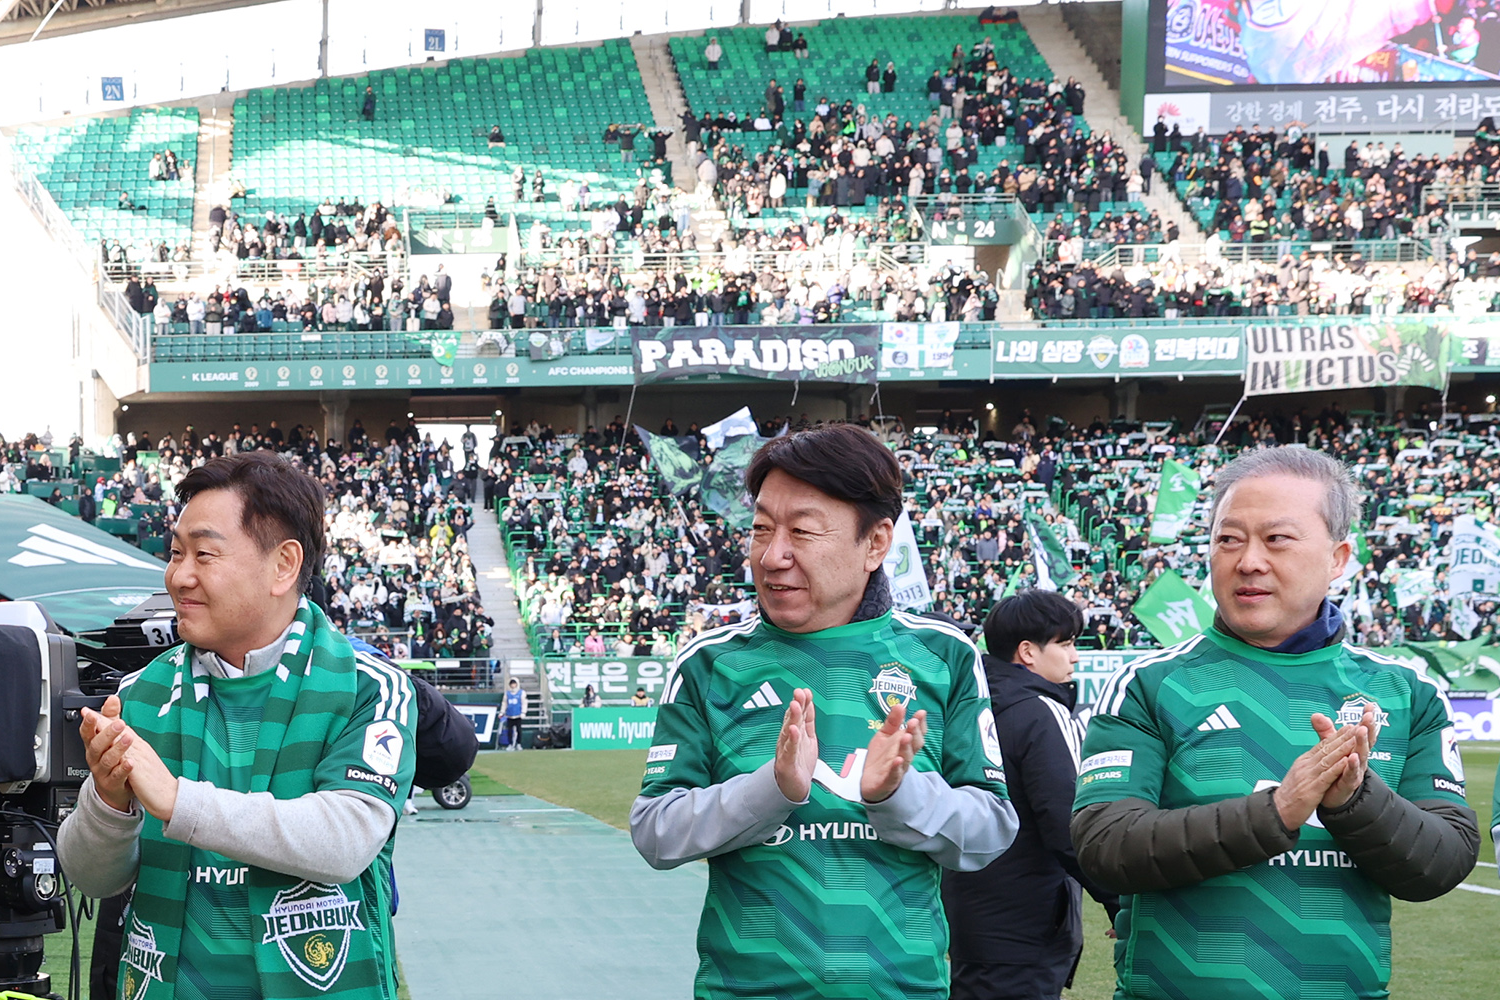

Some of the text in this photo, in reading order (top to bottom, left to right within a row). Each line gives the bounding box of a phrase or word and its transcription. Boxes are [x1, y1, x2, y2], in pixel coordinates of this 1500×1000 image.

[428, 36, 442, 50] 2L
[104, 84, 121, 100] 2N
[1226, 102, 1262, 122] 강한
[1268, 100, 1303, 121] 경제
[1313, 97, 1368, 124] 전주,
[1377, 95, 1424, 121] 다시
[974, 221, 996, 238] 24
[1251, 325, 1355, 354] ULTRAS
[638, 337, 856, 374] PARADISO
[996, 336, 1240, 363] 나의 심장 전북현대
[192, 372, 239, 382] K LEAGUE
[548, 366, 569, 376] AFC
[571, 365, 627, 376] CHAMPIONS
[1250, 353, 1398, 391] INVICTUS
[151, 628, 165, 645] 3
[546, 661, 629, 693] 전북은
[873, 679, 916, 699] JEONBUK
[1337, 711, 1388, 726] JEONUK
[1367, 752, 1392, 761] EARS
[347, 768, 384, 785] IONIQ
[383, 777, 392, 788] 5
[1094, 770, 1122, 780] YEARS
[799, 822, 879, 841] HYUND
[1267, 849, 1358, 869] HYUND
[274, 897, 345, 915] HYUNDAI MOTORS
[266, 907, 362, 936] JEONBUK
[127, 945, 161, 977] NBUK
